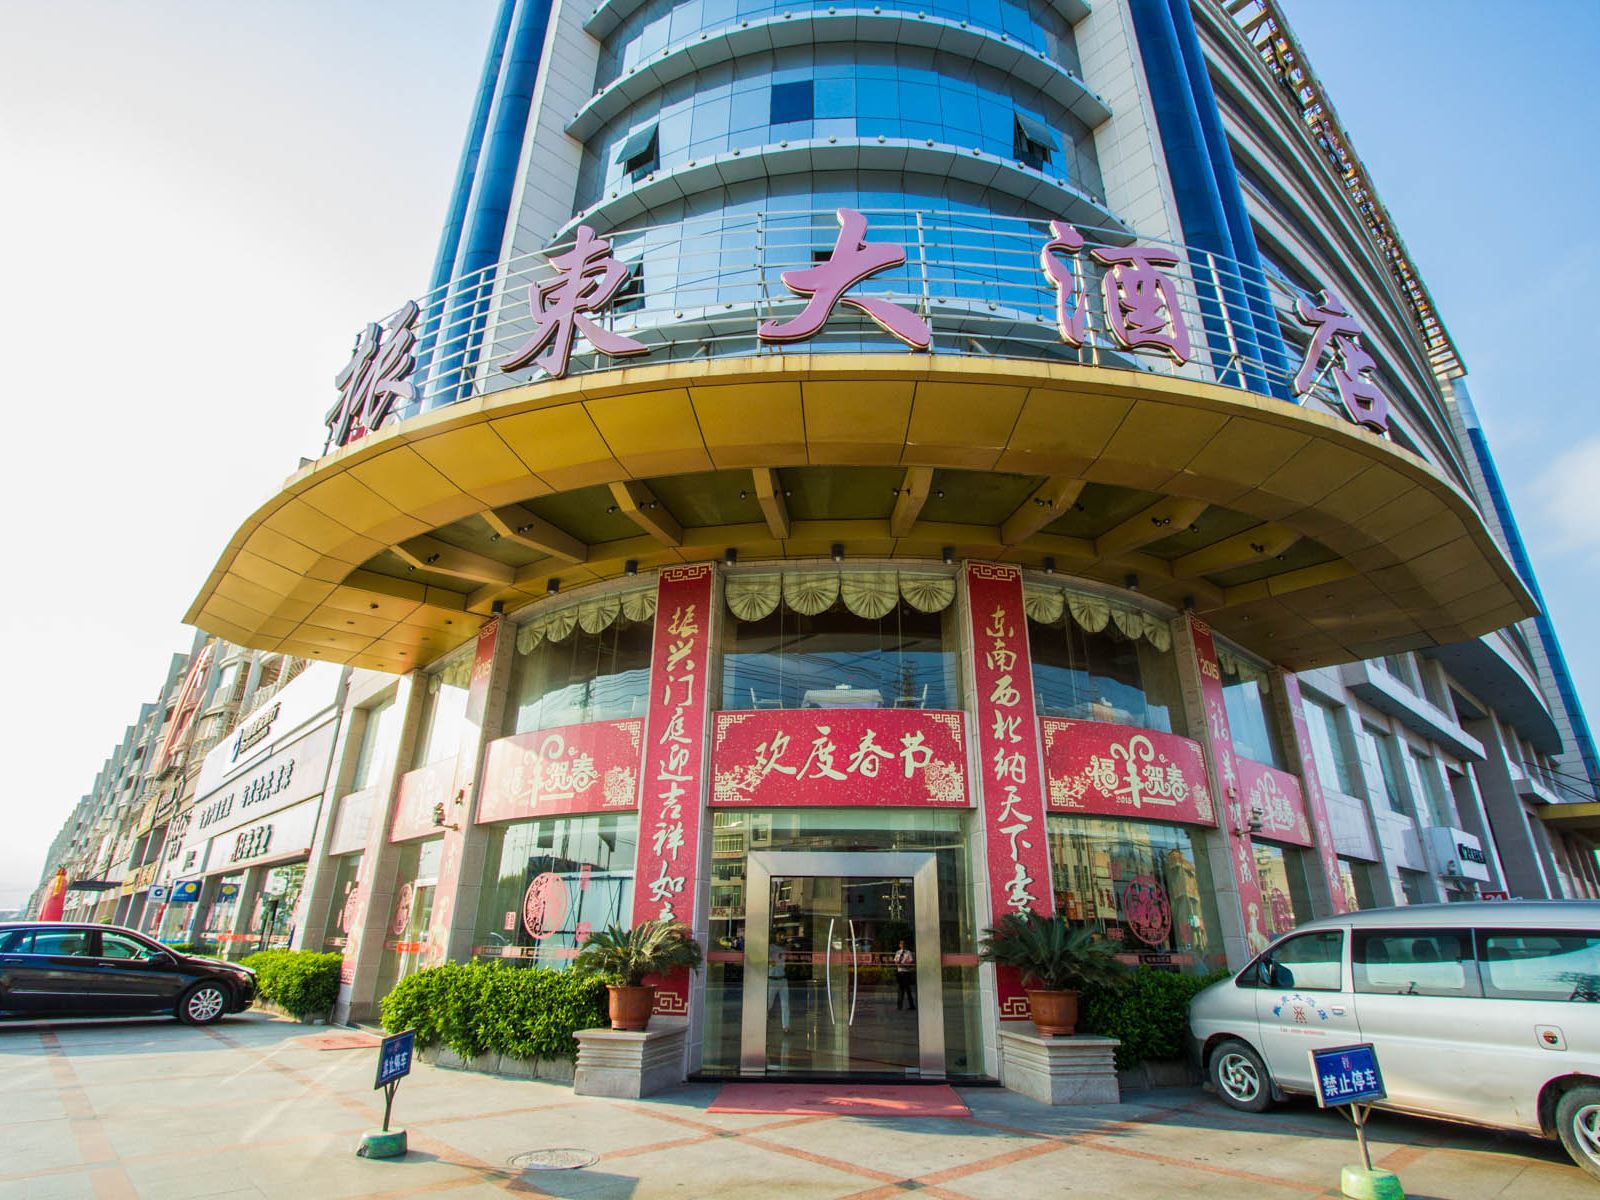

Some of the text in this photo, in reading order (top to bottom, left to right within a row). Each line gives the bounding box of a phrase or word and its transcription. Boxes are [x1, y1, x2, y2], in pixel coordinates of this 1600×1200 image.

[1200, 658, 1219, 680] 2015
[753, 726, 933, 781] 欢度春节
[1085, 735, 1190, 809] 福羊贺春
[1322, 1068, 1377, 1097] 禁止停车
